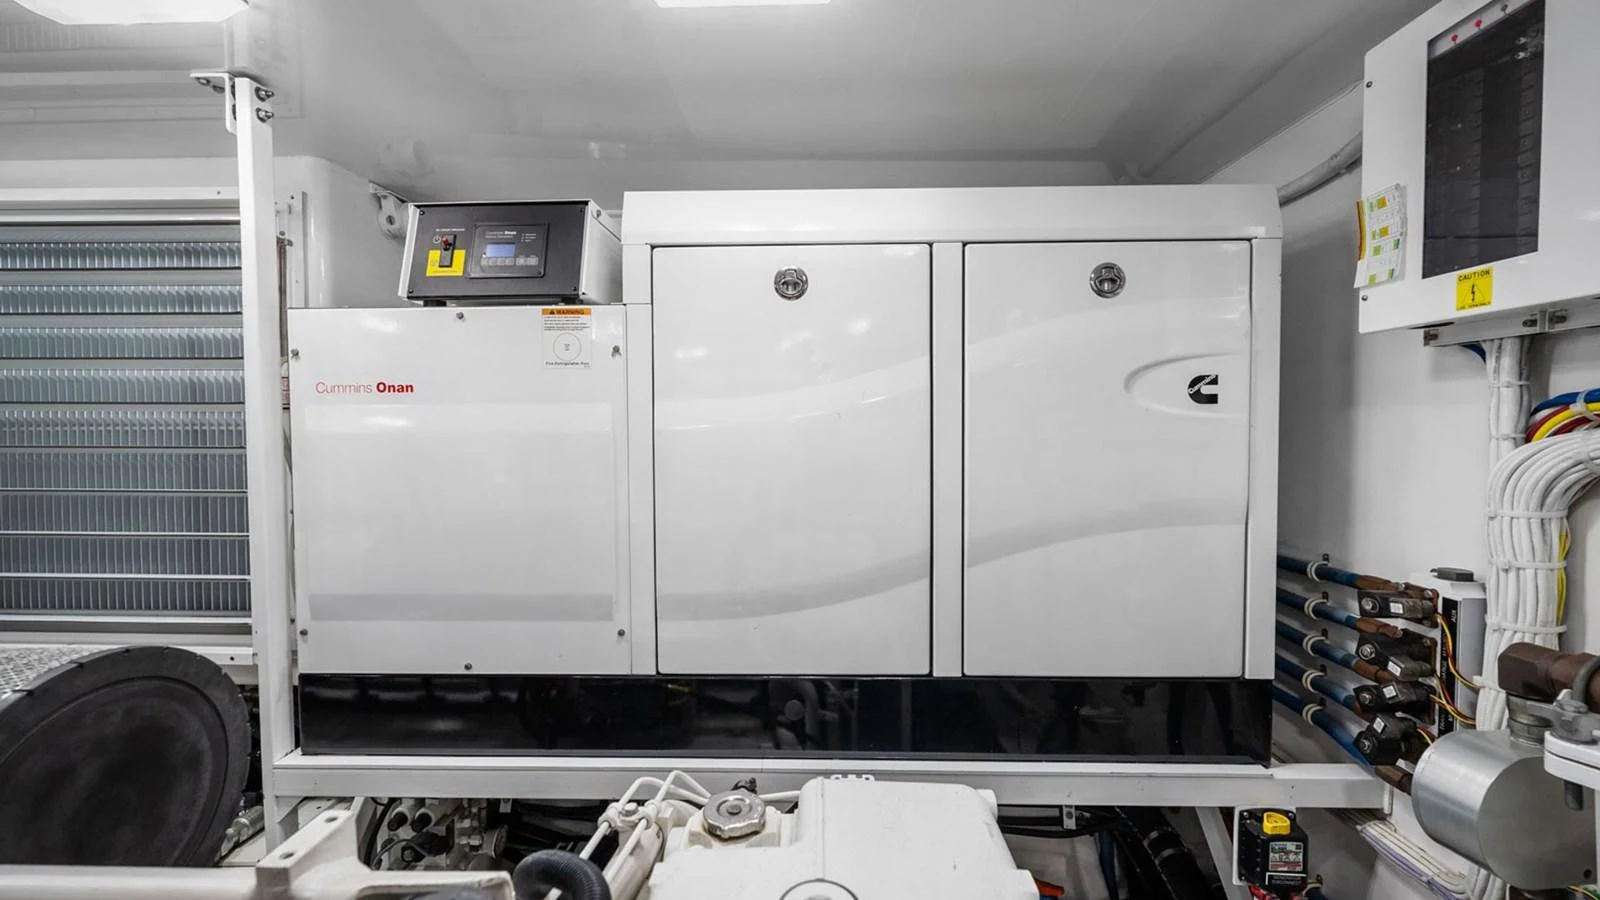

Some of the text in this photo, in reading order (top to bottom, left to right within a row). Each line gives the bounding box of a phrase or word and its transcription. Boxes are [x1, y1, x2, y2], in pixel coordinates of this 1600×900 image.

[1458, 269, 1490, 281] CAUTION
[315, 382, 414, 394] Cummins Onan
